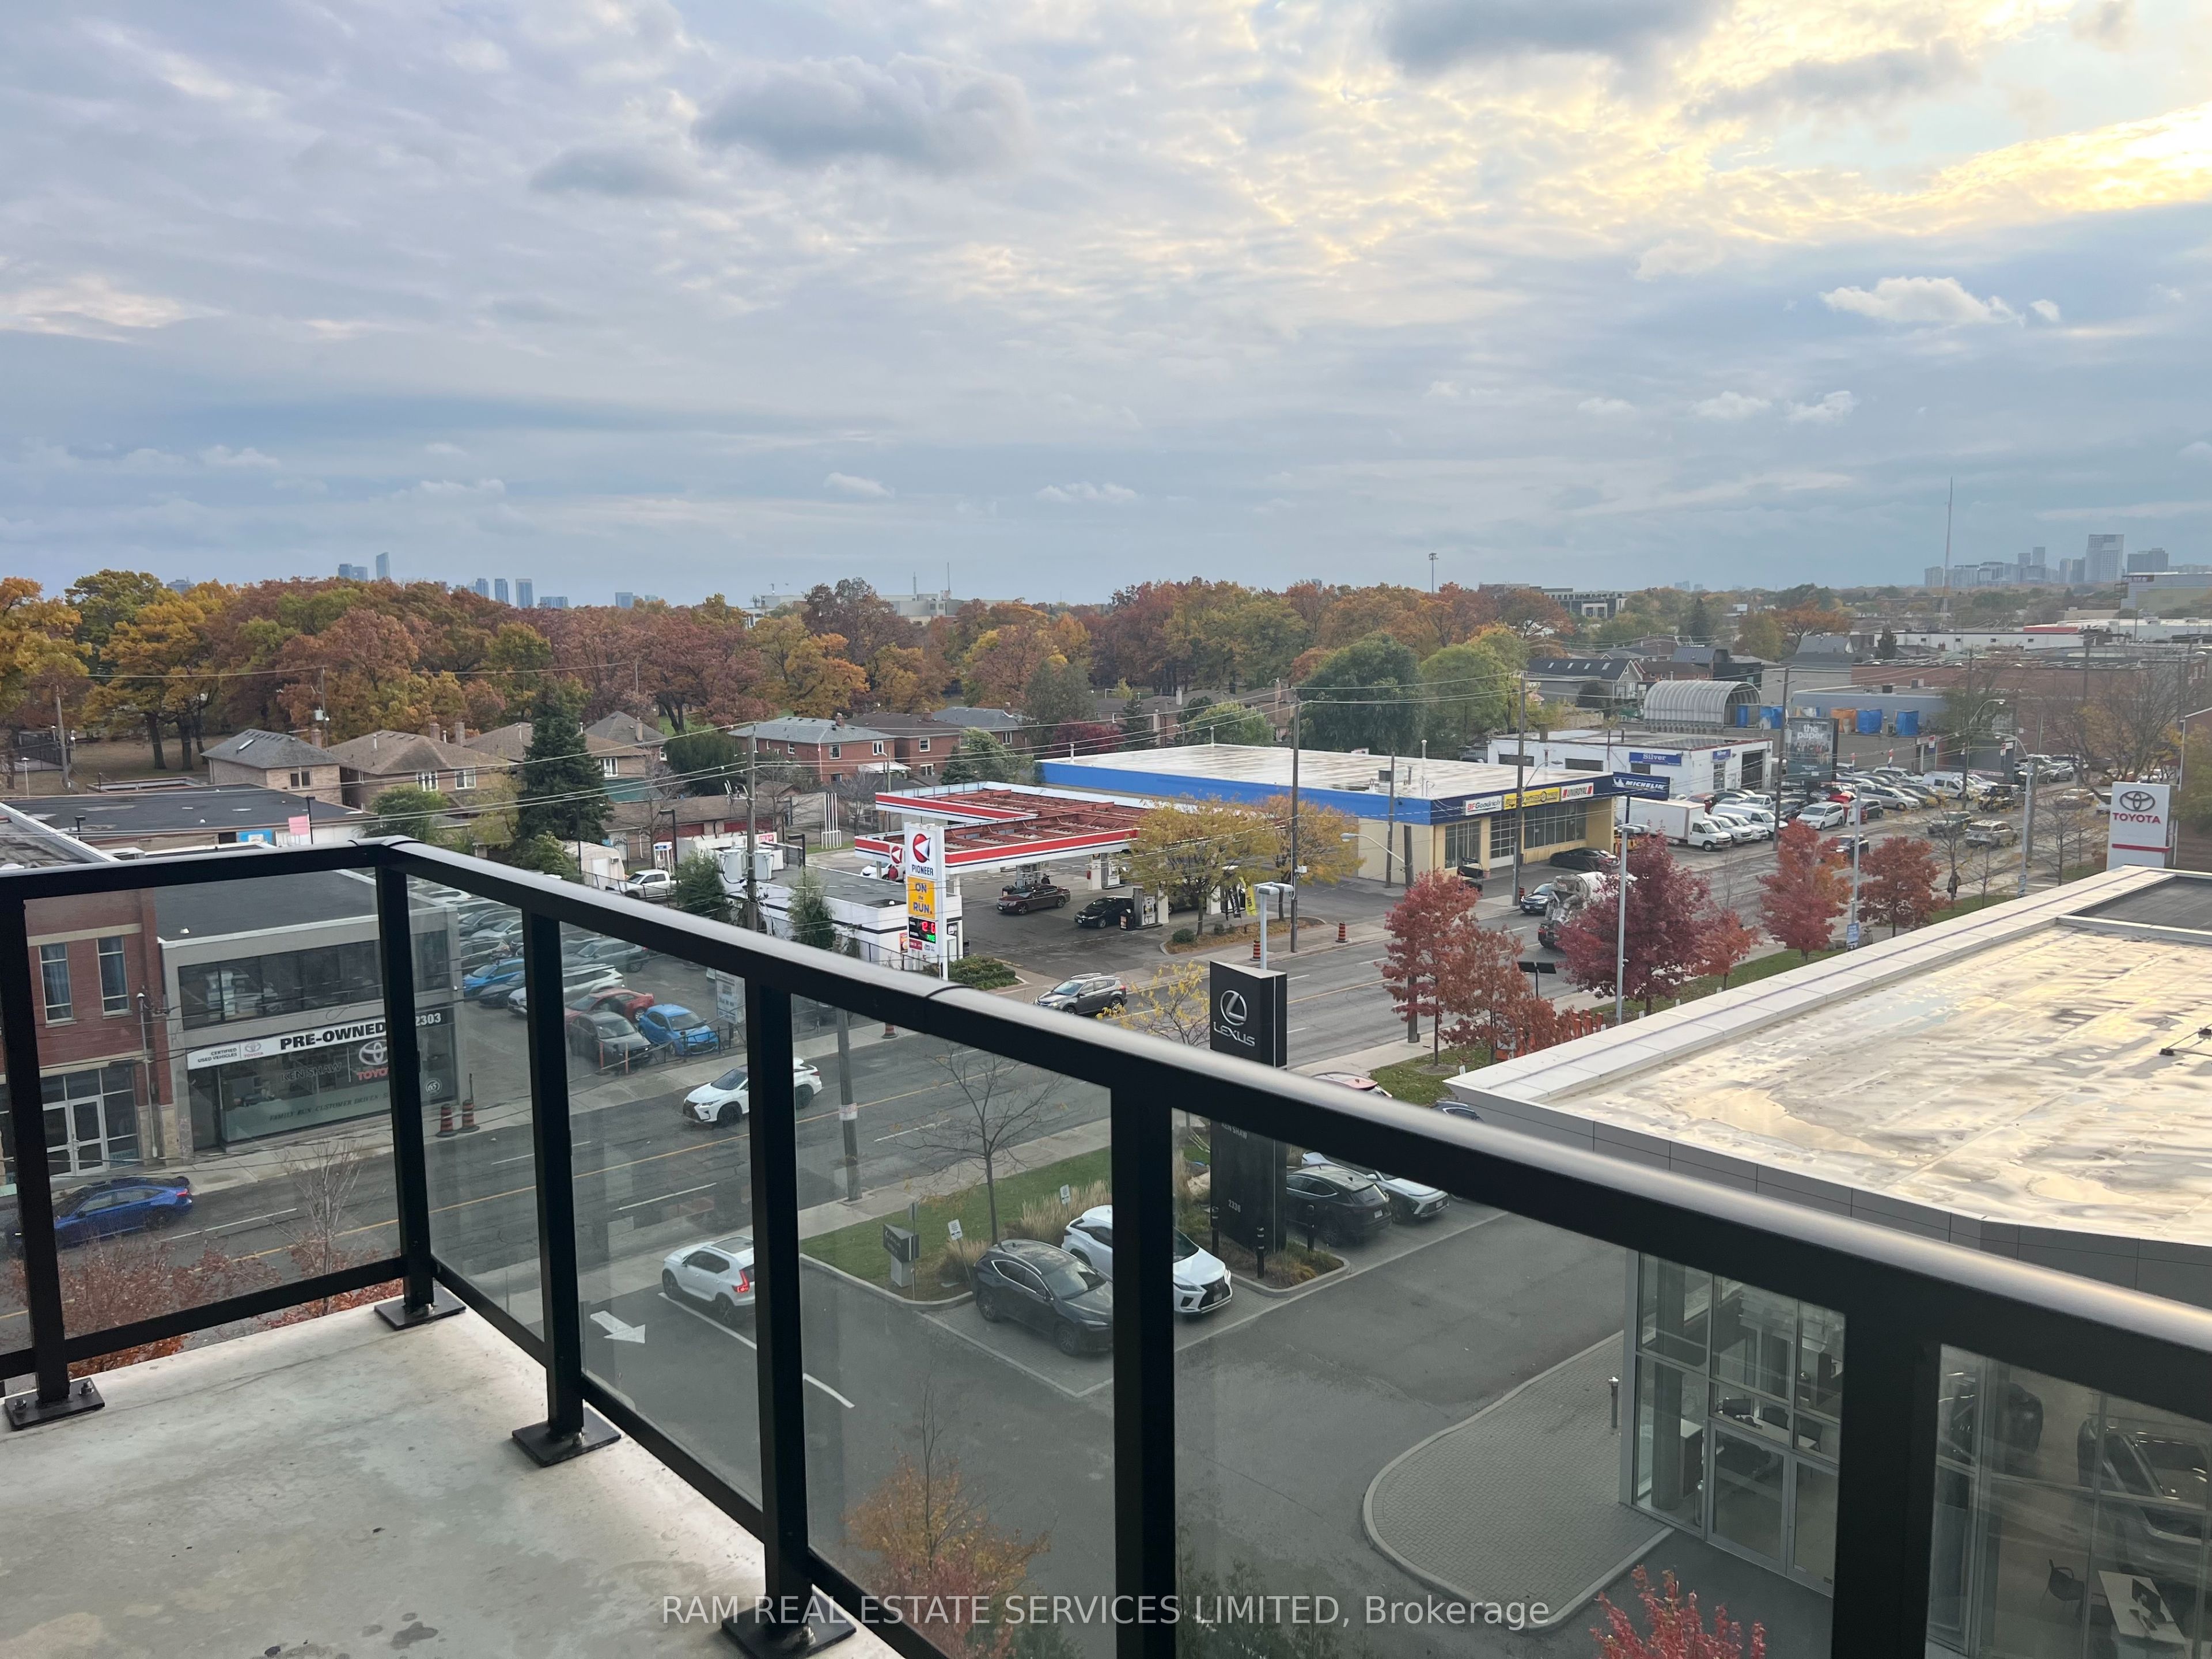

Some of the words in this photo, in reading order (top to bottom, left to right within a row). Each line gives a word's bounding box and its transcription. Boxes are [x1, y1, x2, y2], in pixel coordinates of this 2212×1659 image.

[1803, 724, 1819, 733] the
[1797, 732, 1824, 740] paper
[1643, 753, 1666, 762] Silver
[1625, 780, 1665, 790] MICHELIN
[1468, 800, 1501, 810] BFGoodrich
[2112, 812, 2161, 824] TOYOTA
[911, 864, 934, 876] PIONEER
[915, 882, 927, 893] ON
[415, 1013, 441, 1027] 2303
[280, 1021, 387, 1051] PRE-OWNED
[1213, 1021, 1255, 1047] LEXUS
[211, 1048, 237, 1056] CERTIFIED
[282, 1070, 305, 1082] KEN
[306, 1062, 342, 1078] SHAW
[357, 1067, 388, 1081] TOYO
[315, 1100, 353, 1112] CUSTOMER
[1232, 1126, 1248, 1139] SHAW
